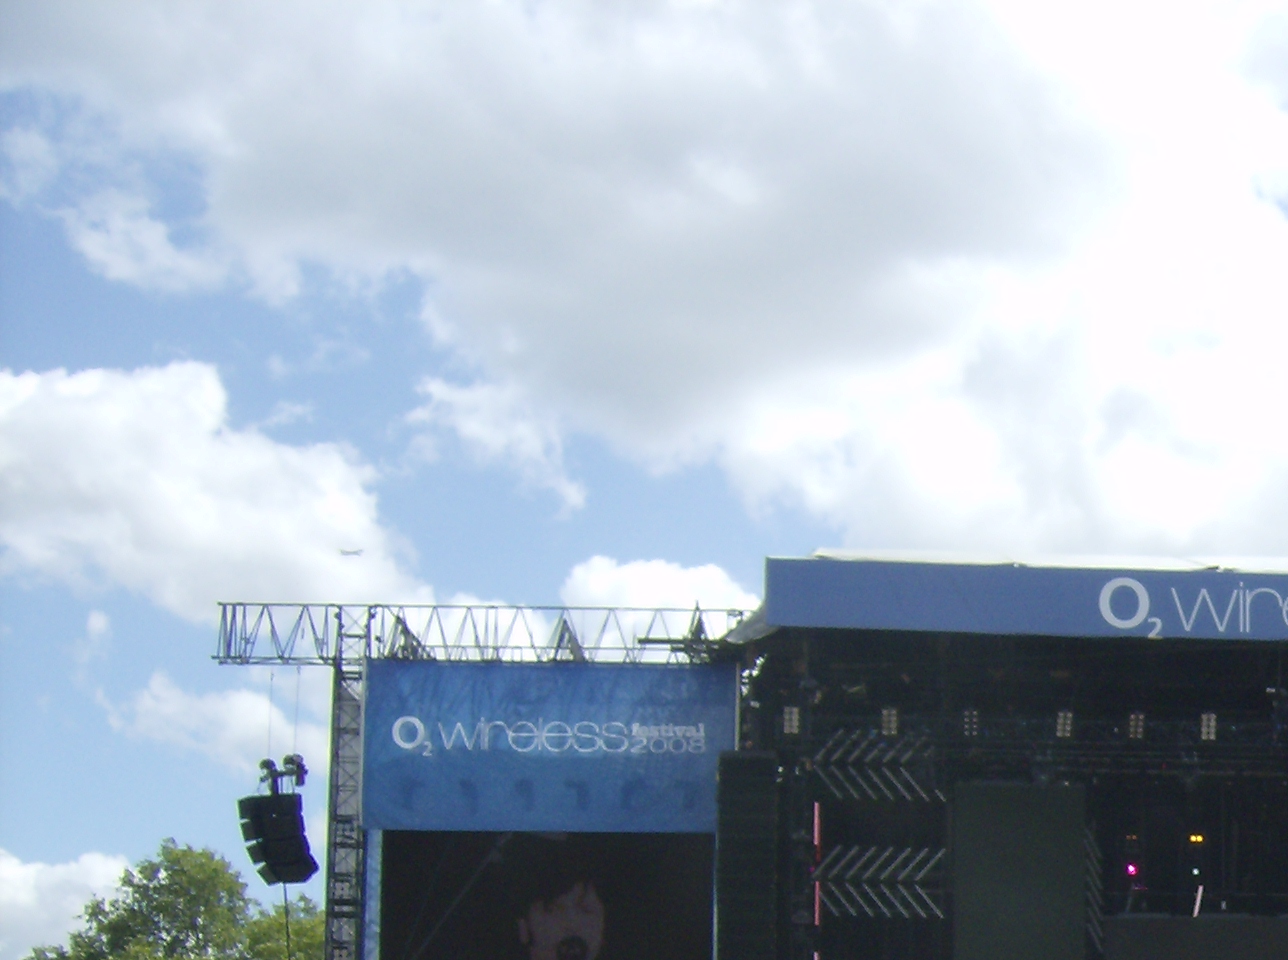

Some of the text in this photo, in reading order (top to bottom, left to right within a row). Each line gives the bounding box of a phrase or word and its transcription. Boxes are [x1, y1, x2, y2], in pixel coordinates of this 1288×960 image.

[438, 716, 629, 753] wireless
[631, 722, 706, 737] festival
[630, 736, 706, 754] 2008
